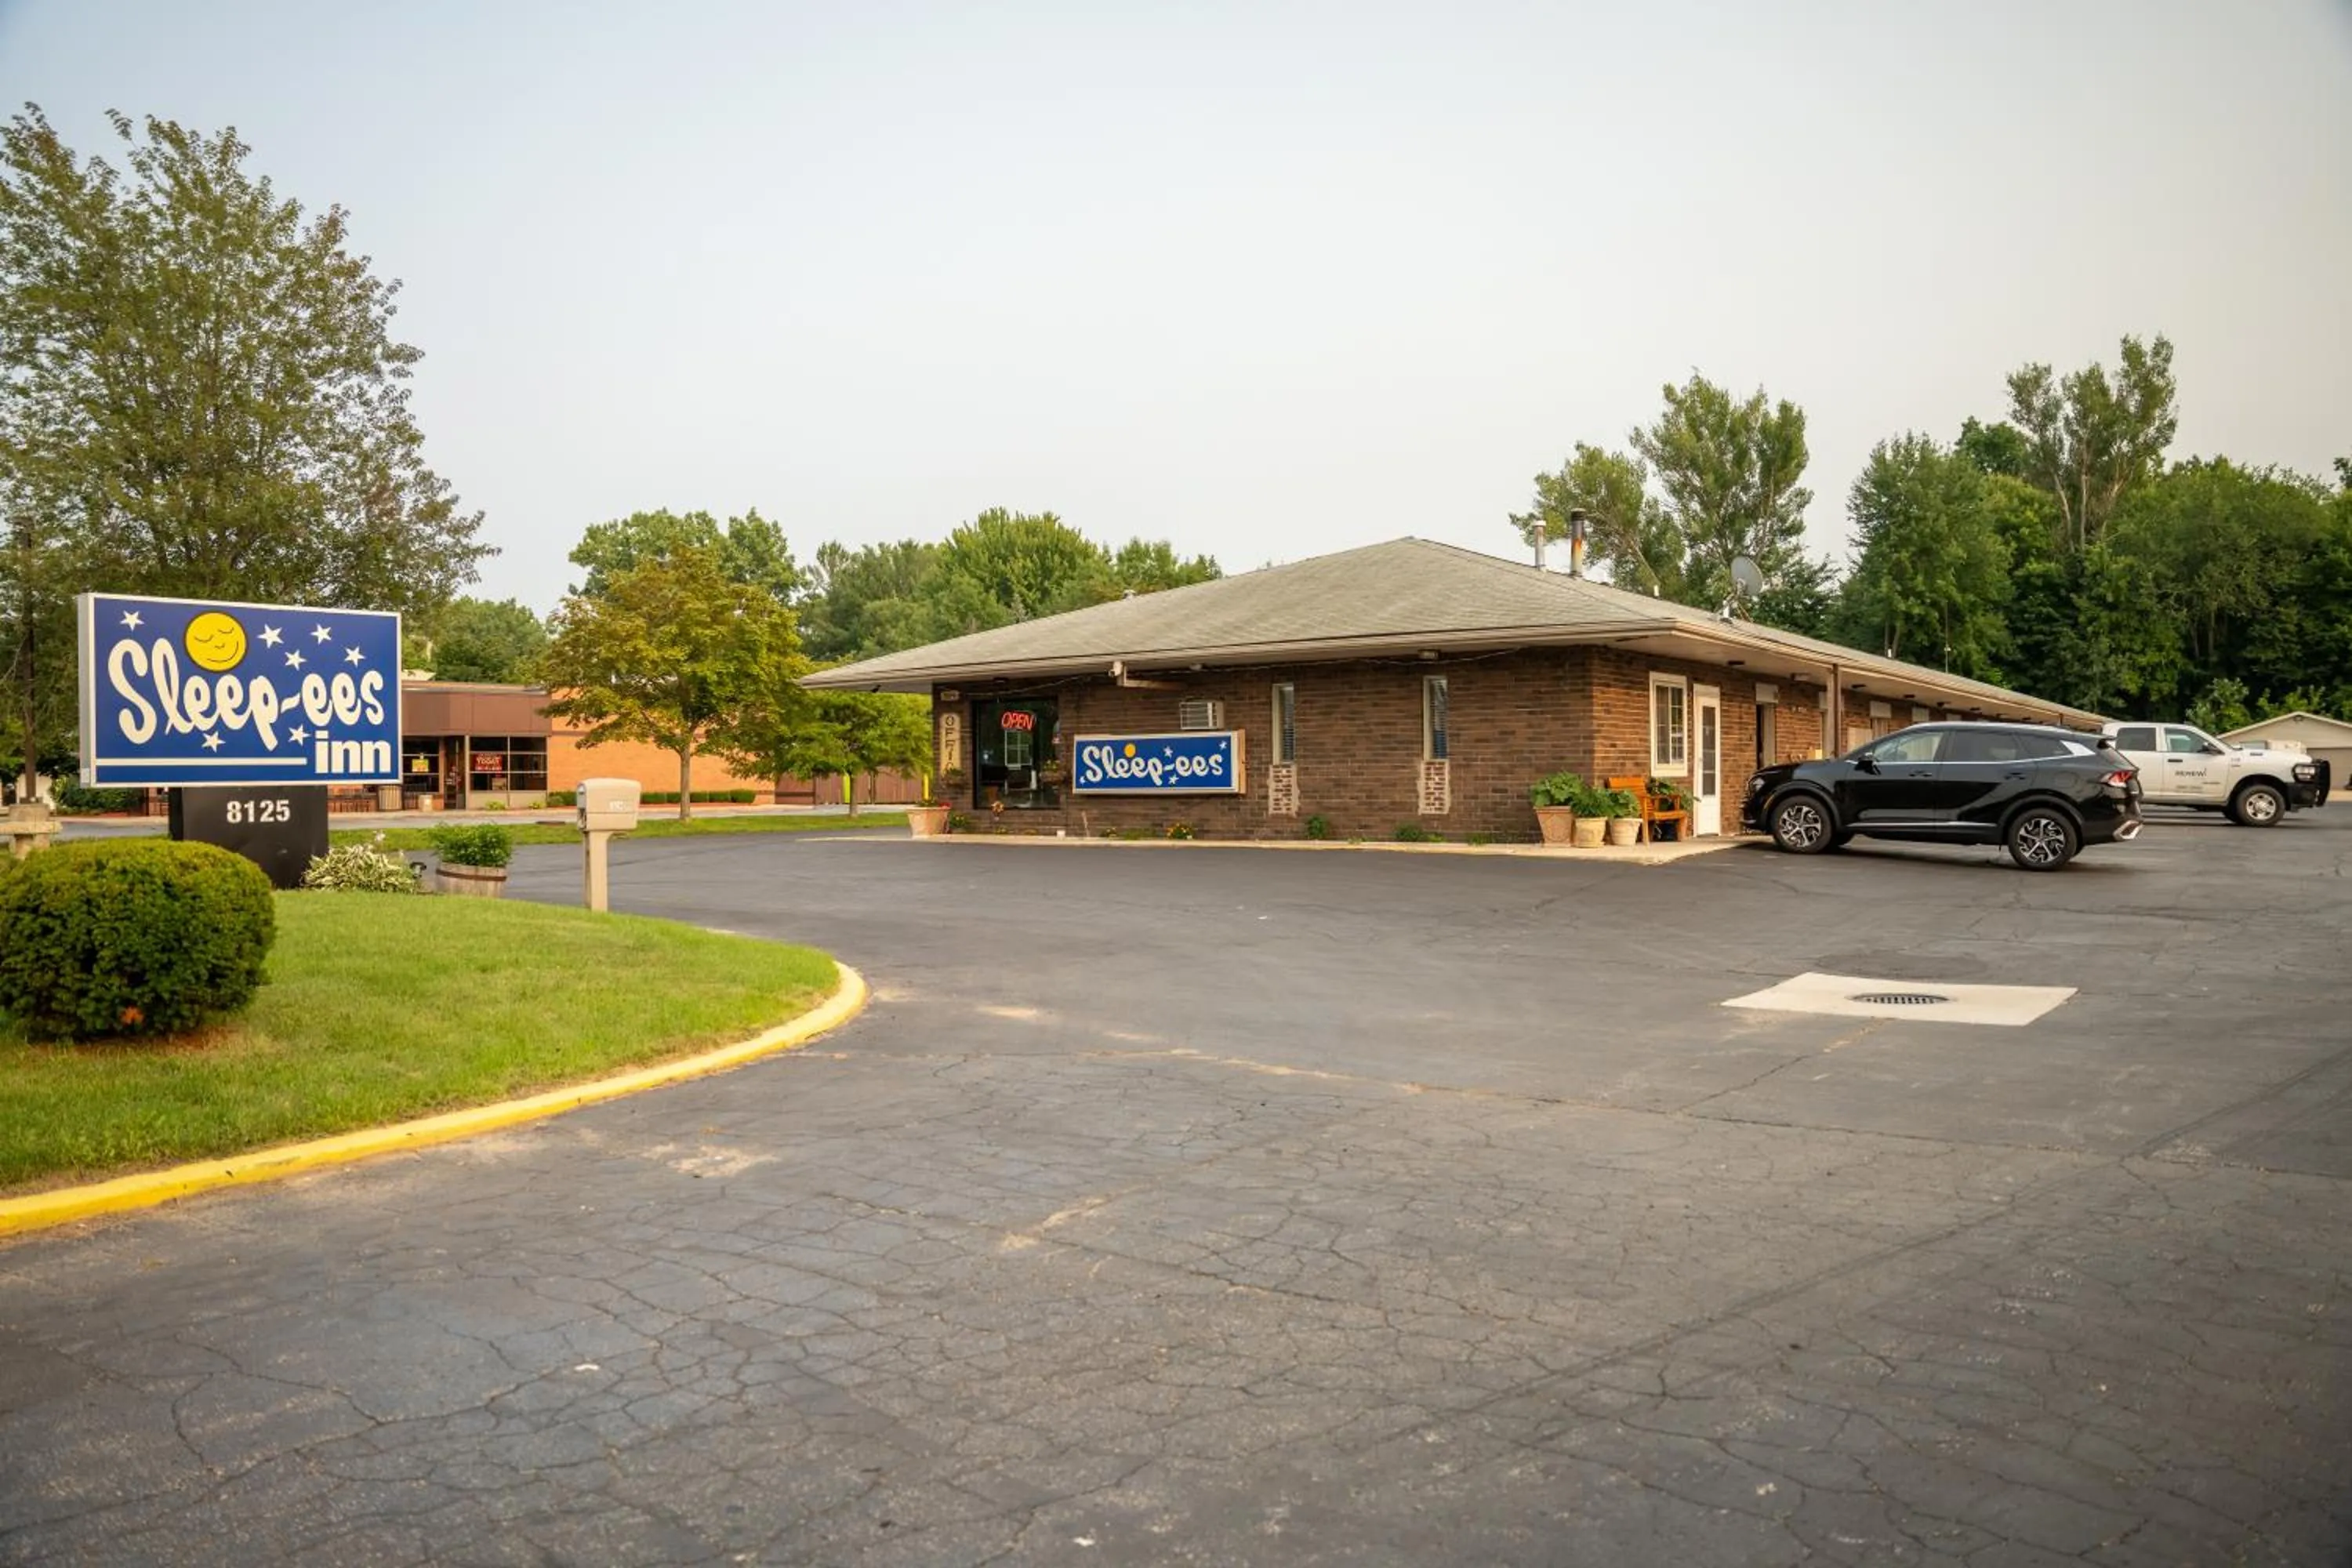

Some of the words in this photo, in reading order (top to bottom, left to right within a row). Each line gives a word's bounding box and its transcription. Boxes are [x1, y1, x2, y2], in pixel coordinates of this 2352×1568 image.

[108, 637, 384, 752] Sleep-ees
[945, 714, 956, 771] OFFIC
[1001, 712, 1035, 731] OPEN
[314, 730, 391, 774] inn
[1082, 745, 1224, 786] Sleep-ees
[227, 800, 290, 823] 8125
